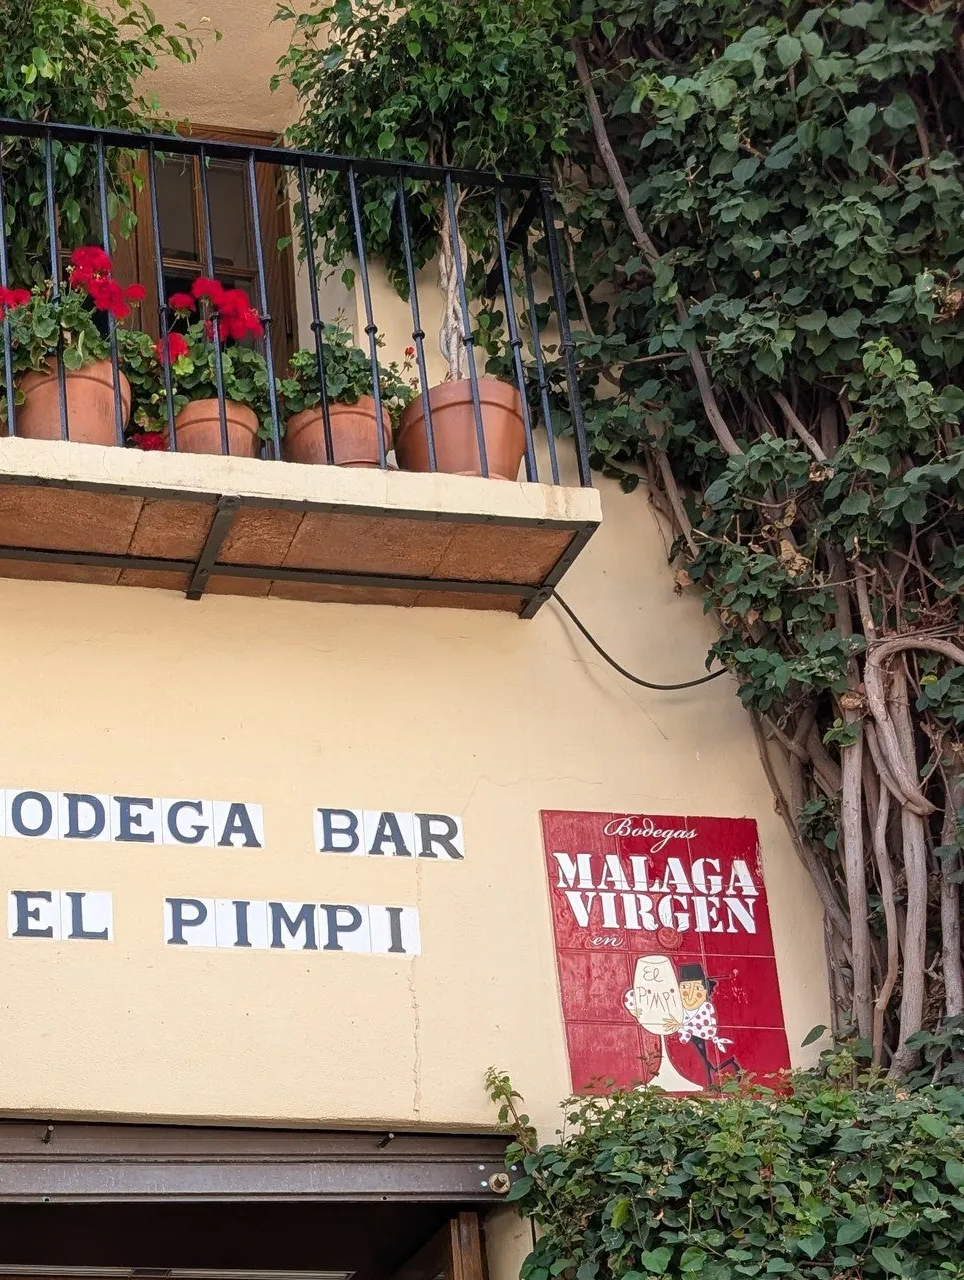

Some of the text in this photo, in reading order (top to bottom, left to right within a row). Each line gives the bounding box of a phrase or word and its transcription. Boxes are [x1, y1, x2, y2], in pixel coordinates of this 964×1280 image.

[317, 808, 464, 860] BAR
[604, 815, 698, 853] Bodegas
[552, 852, 759, 896] MALAGA
[11, 889, 407, 953] EL PIMPI
[564, 890, 757, 934] VIRGEN
[588, 933, 624, 947] en
[643, 965, 664, 983] El
